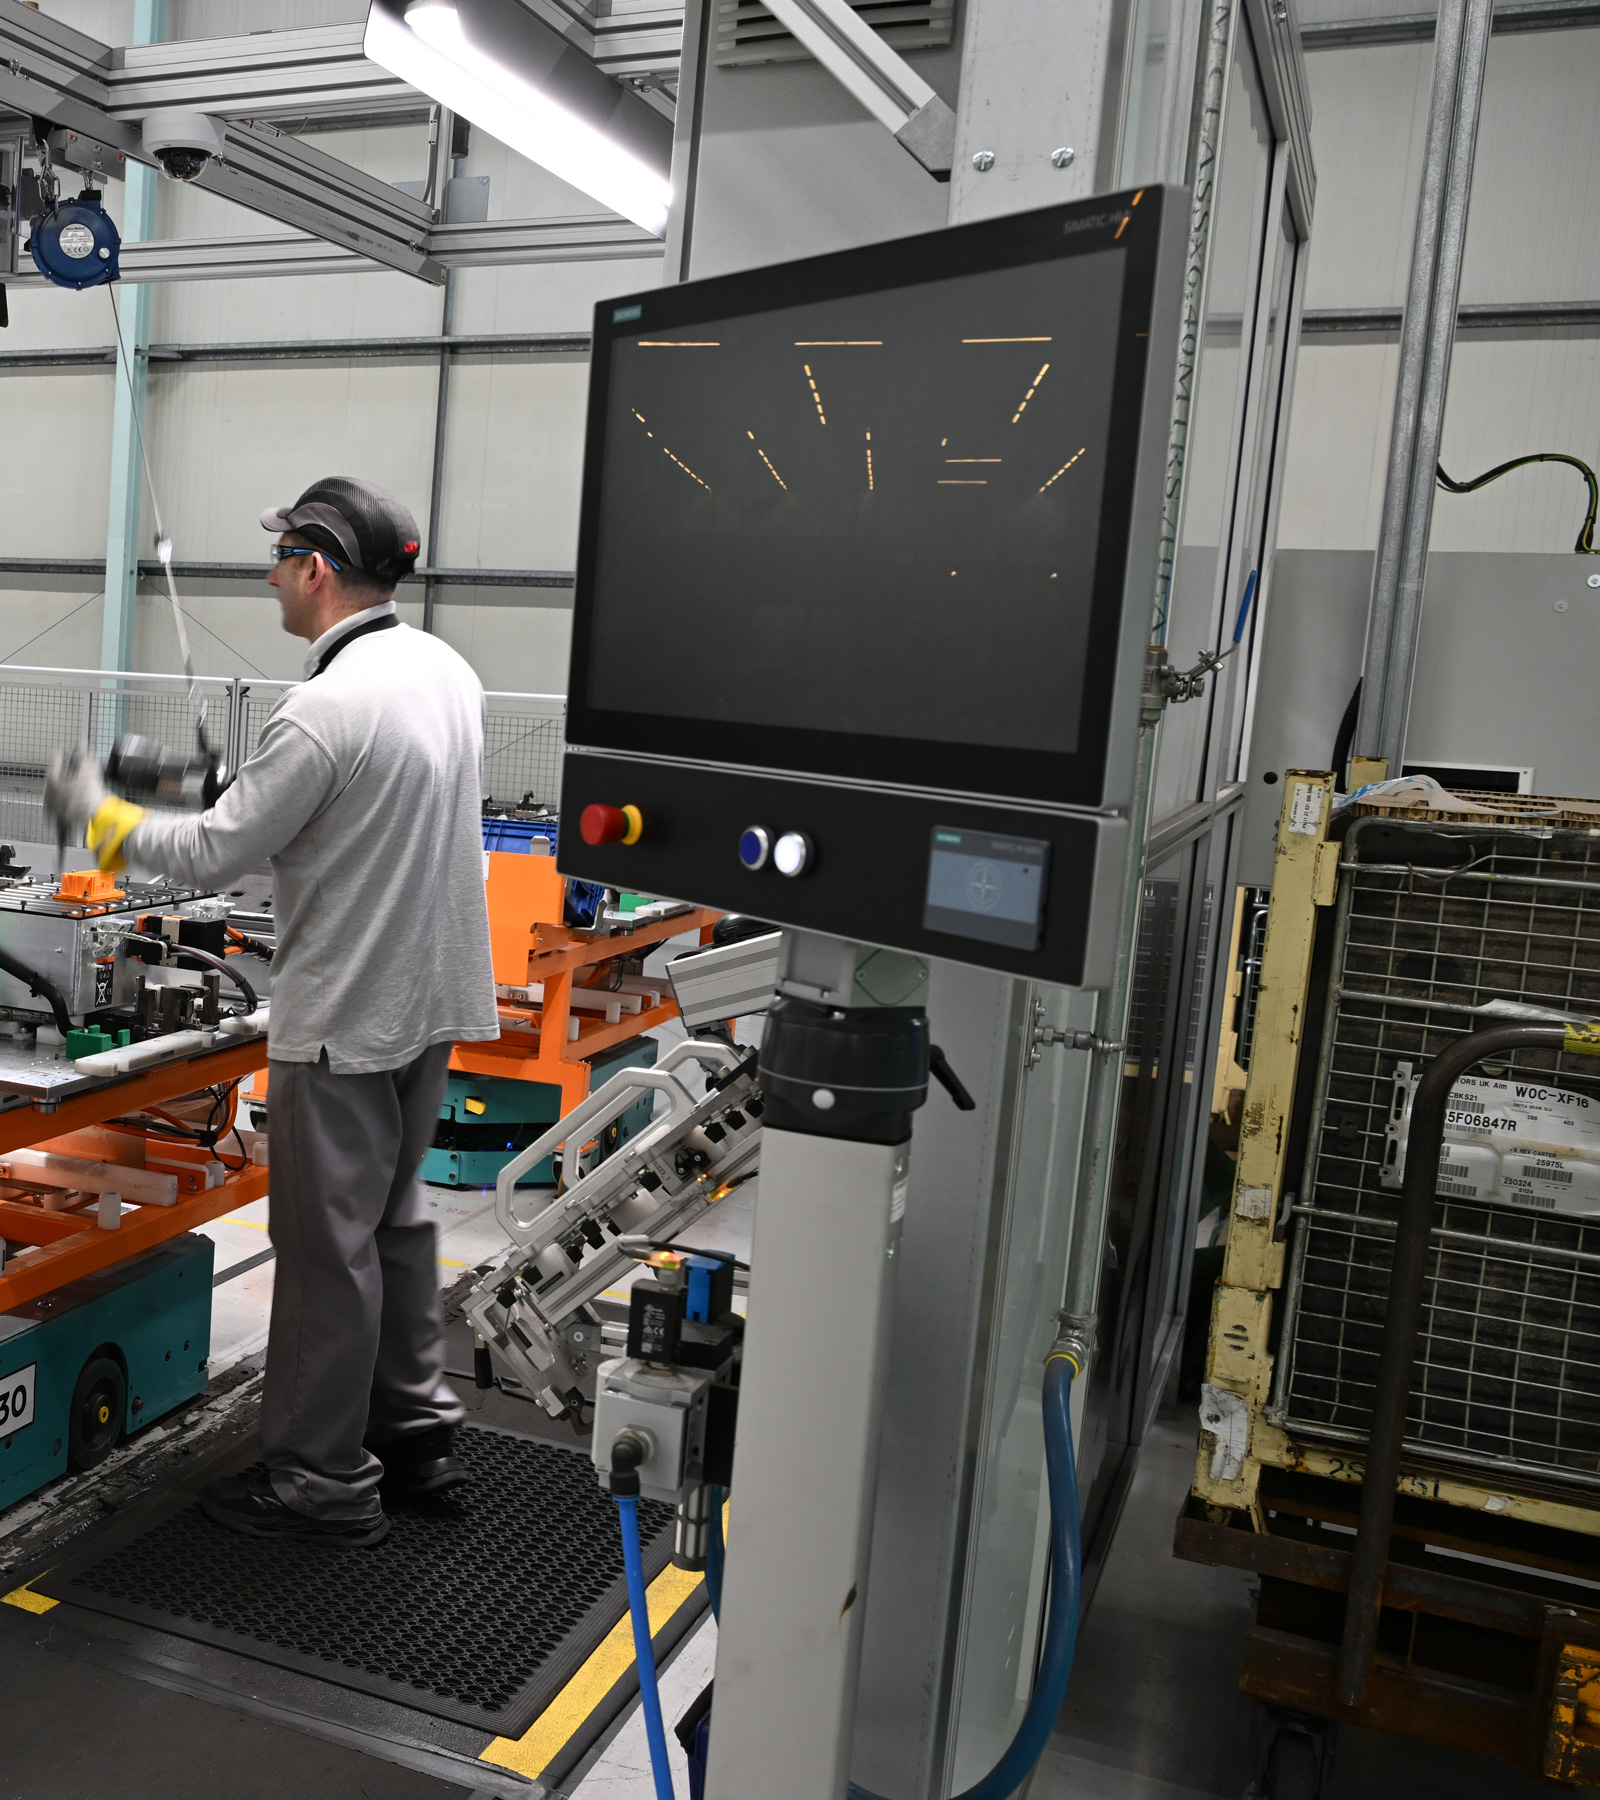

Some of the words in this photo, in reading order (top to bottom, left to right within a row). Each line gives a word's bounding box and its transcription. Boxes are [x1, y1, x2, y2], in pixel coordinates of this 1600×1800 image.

[1444, 1111, 1517, 1132] 5F06847R
[1536, 1158, 1564, 1169] 25975L
[1504, 1177, 1532, 1188] 250324
